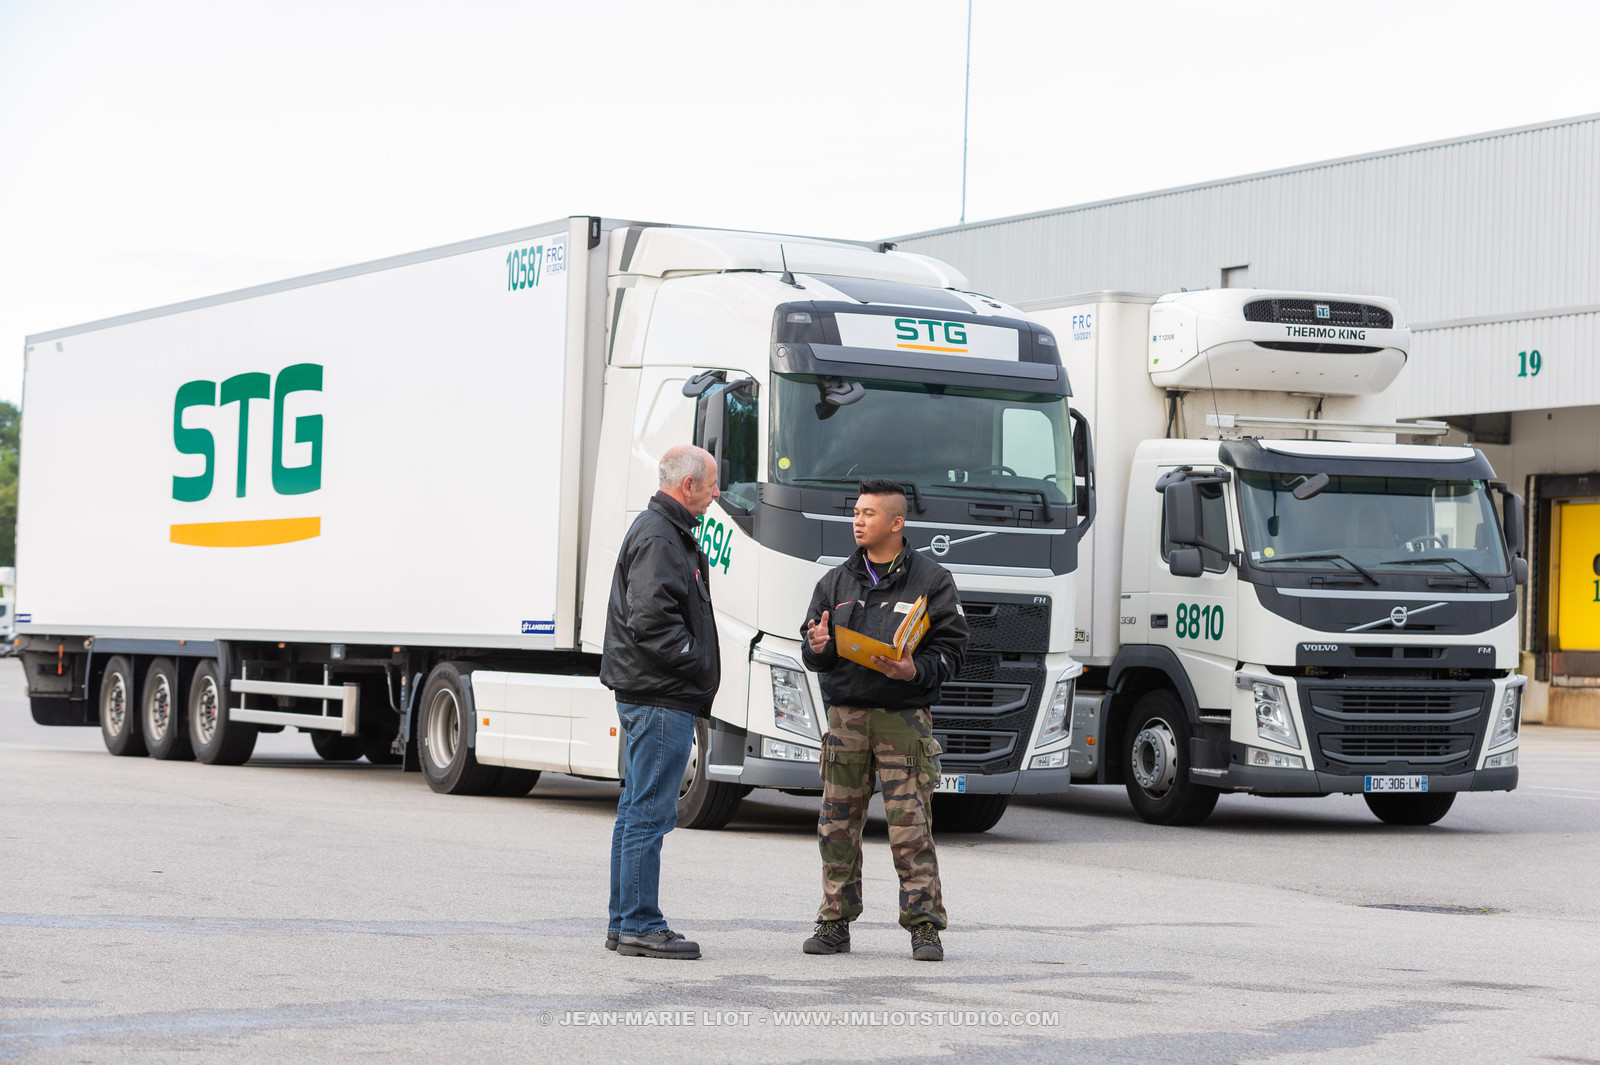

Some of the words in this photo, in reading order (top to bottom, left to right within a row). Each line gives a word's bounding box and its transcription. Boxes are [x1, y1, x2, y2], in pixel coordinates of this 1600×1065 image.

[546, 246, 563, 263] FRC
[506, 245, 543, 291] 10587
[1072, 314, 1092, 330] FRC
[894, 318, 967, 345] STG
[1285, 326, 1337, 339] THERMO
[1338, 329, 1366, 340] KING
[1517, 349, 1542, 378] 19
[172, 362, 323, 502] STG
[1033, 596, 1047, 604] FH
[1120, 616, 1137, 625] 330
[1176, 602, 1225, 641] 8810
[1302, 644, 1338, 652] VOLVO
